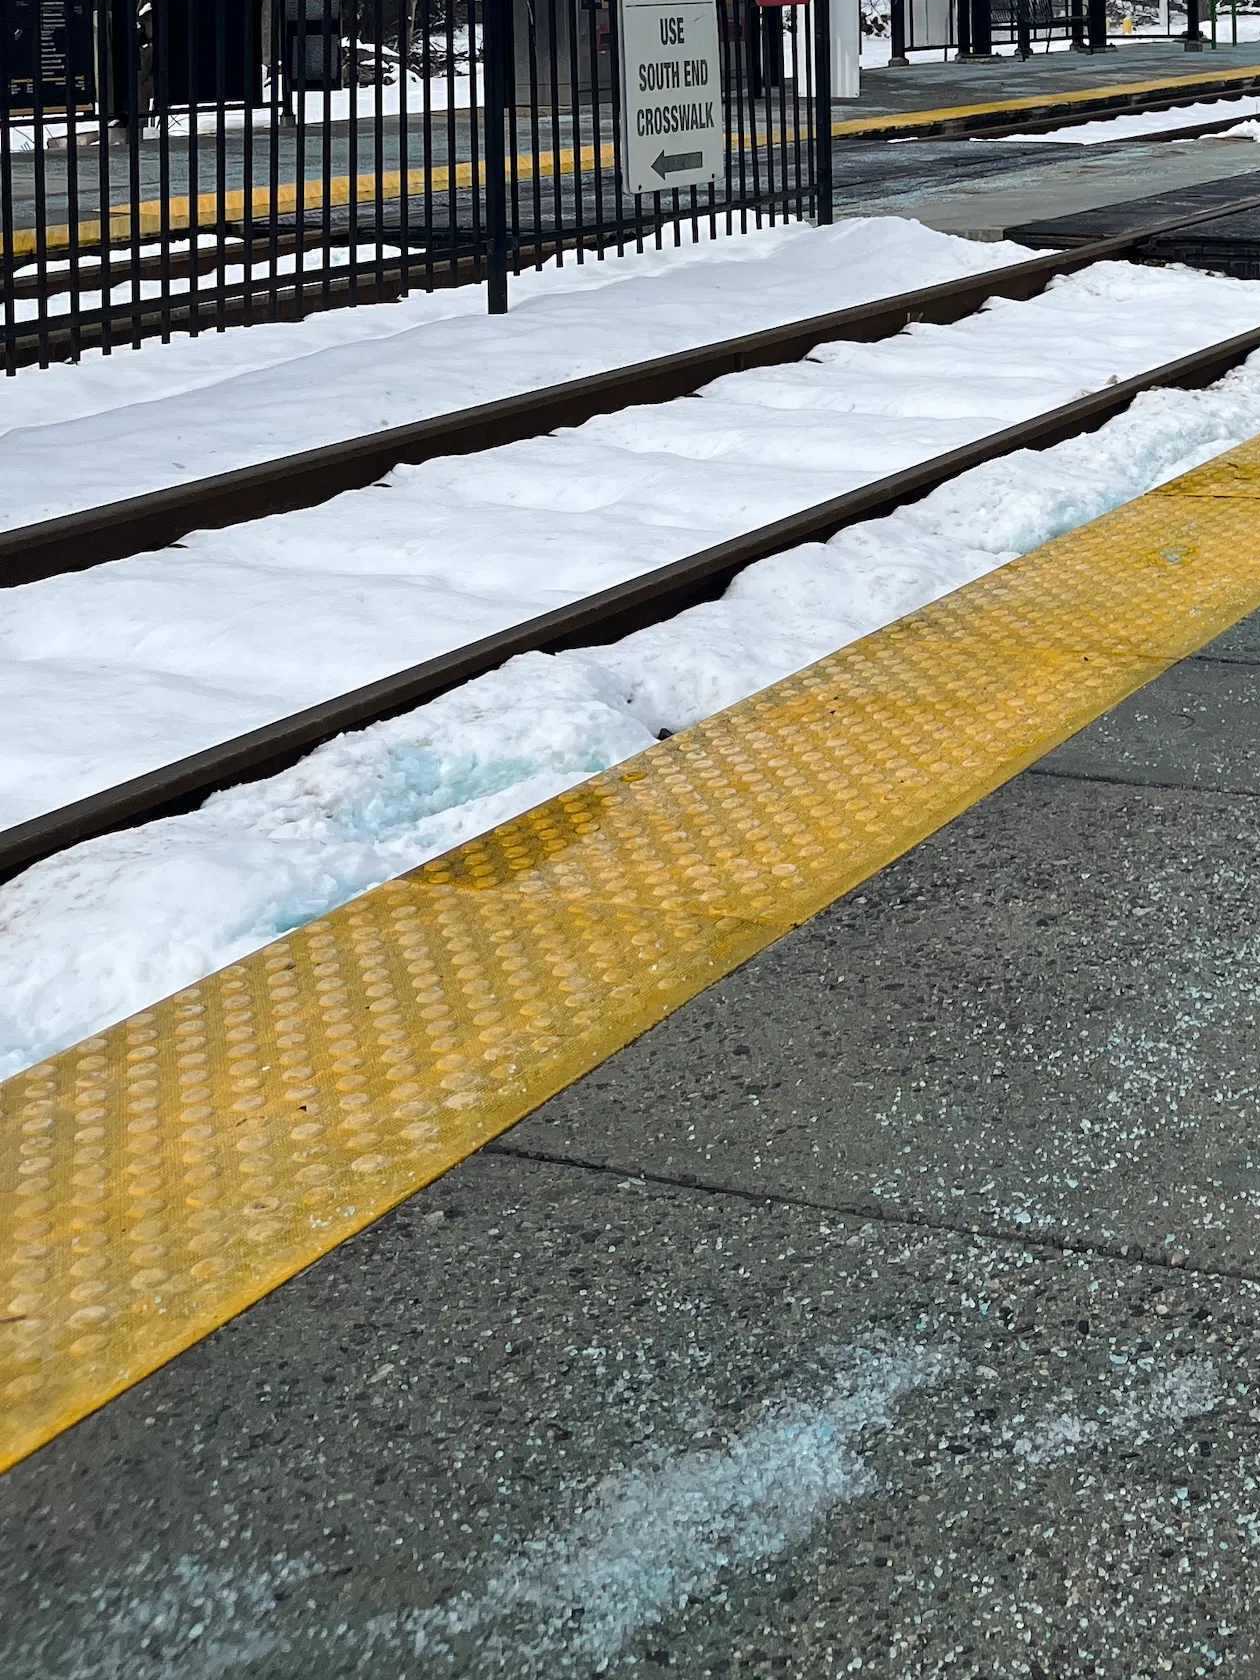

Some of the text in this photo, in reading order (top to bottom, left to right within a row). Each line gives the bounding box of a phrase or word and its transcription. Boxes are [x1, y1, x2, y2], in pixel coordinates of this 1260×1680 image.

[659, 17, 685, 45] USE
[639, 59, 708, 92] SOUTH END
[637, 101, 714, 137] CROSSWALK
